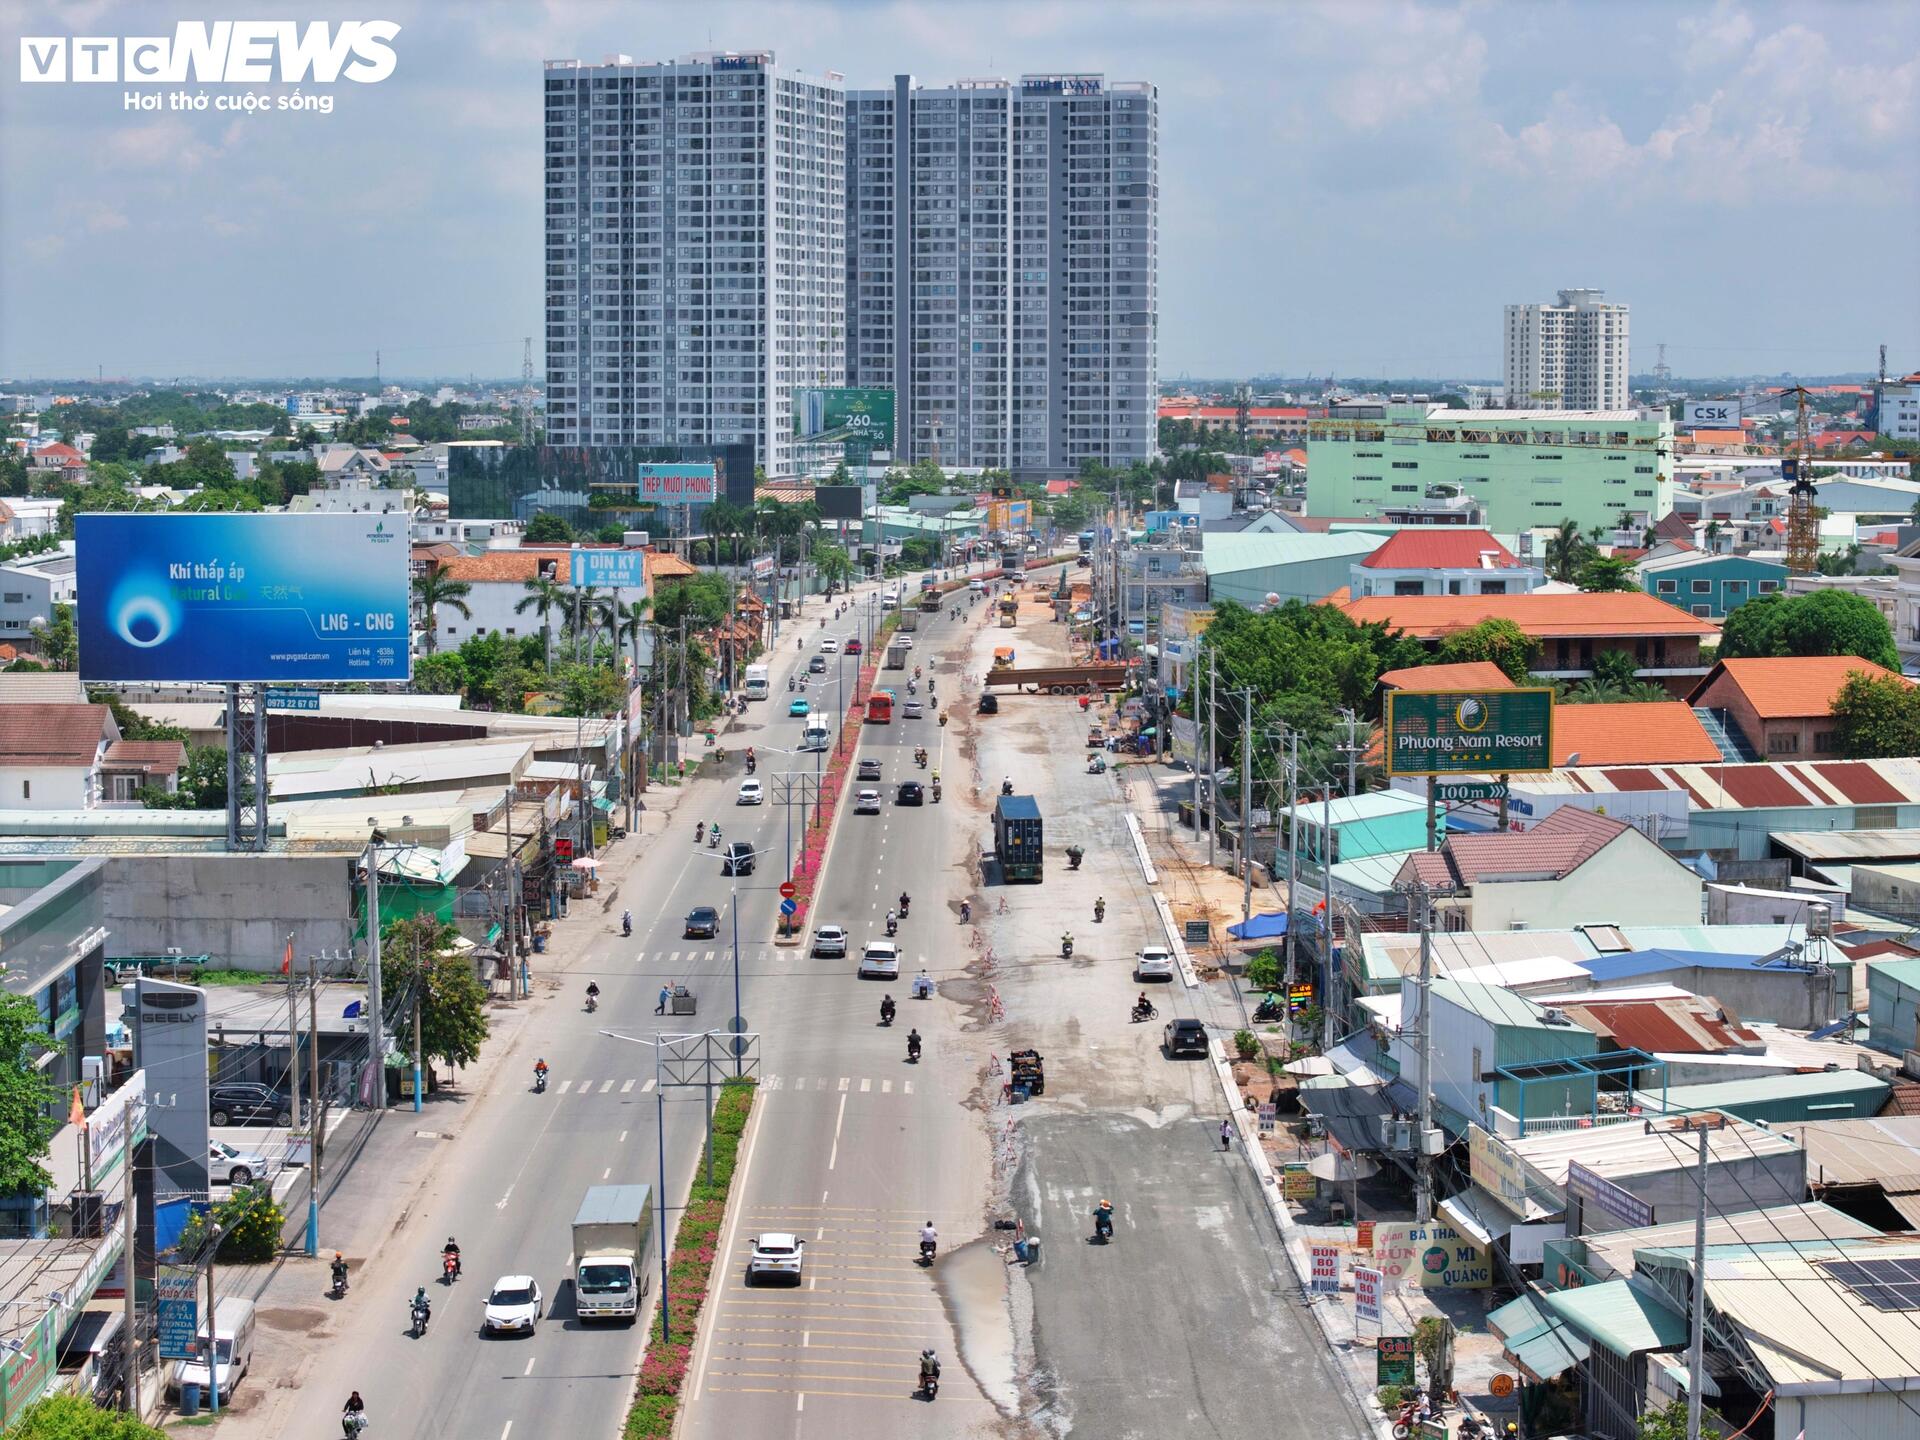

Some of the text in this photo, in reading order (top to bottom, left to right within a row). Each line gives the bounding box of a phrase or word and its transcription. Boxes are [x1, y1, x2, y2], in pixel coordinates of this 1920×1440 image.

[1694, 408, 1728, 419] CSK
[845, 414, 871, 427] 260
[685, 477, 711, 493] PHONG
[169, 558, 245, 583] Khí thấp áp
[596, 571, 630, 579] 2 KM
[171, 585, 220, 601] Natural
[320, 613, 348, 631] LNG
[366, 612, 394, 631] CNG
[270, 653, 330, 662] www.pvgasd.com.vn
[348, 658, 370, 666] Hotline
[267, 699, 318, 708] 0975 22 67 67
[1458, 735, 1491, 748] Nam
[1495, 734, 1543, 747] Resort
[1440, 786, 1484, 799] 100 m
[142, 1013, 198, 1023] GEELY
[1432, 1228, 1461, 1241] THẠ
[1375, 1246, 1417, 1260] BÚN
[1443, 1265, 1488, 1286] QUẢNG
